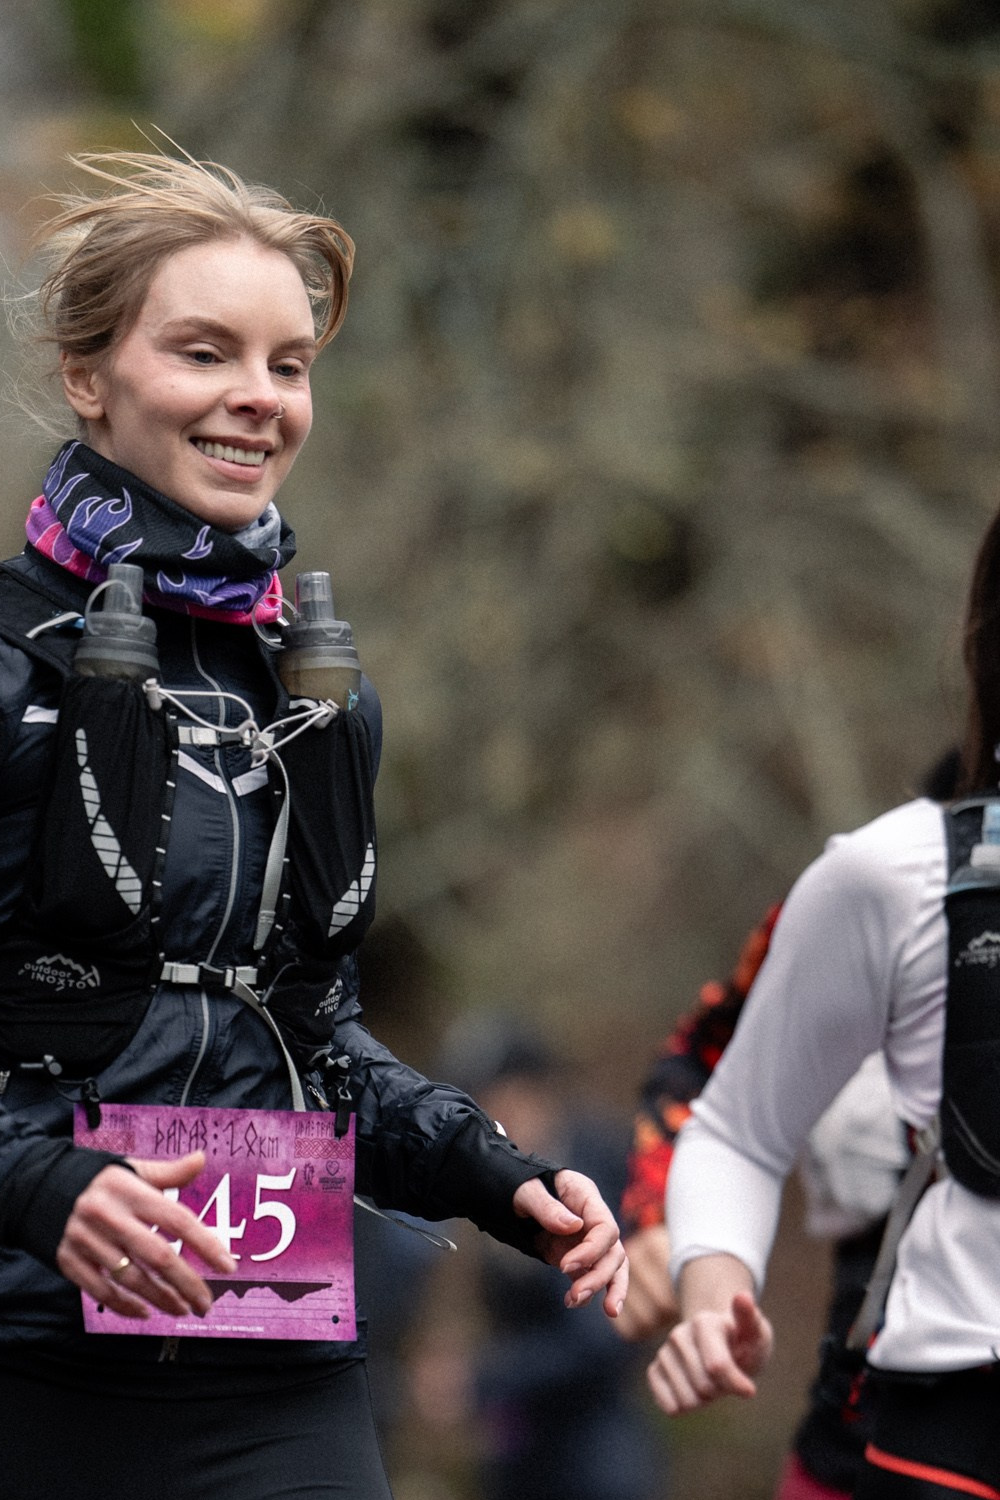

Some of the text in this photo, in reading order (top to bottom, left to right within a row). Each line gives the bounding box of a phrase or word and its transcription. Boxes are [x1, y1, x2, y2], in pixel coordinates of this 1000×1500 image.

[24, 963, 72, 978] outdoor
[325, 1002, 339, 1014] INO
[150, 1167, 297, 1262] 45
